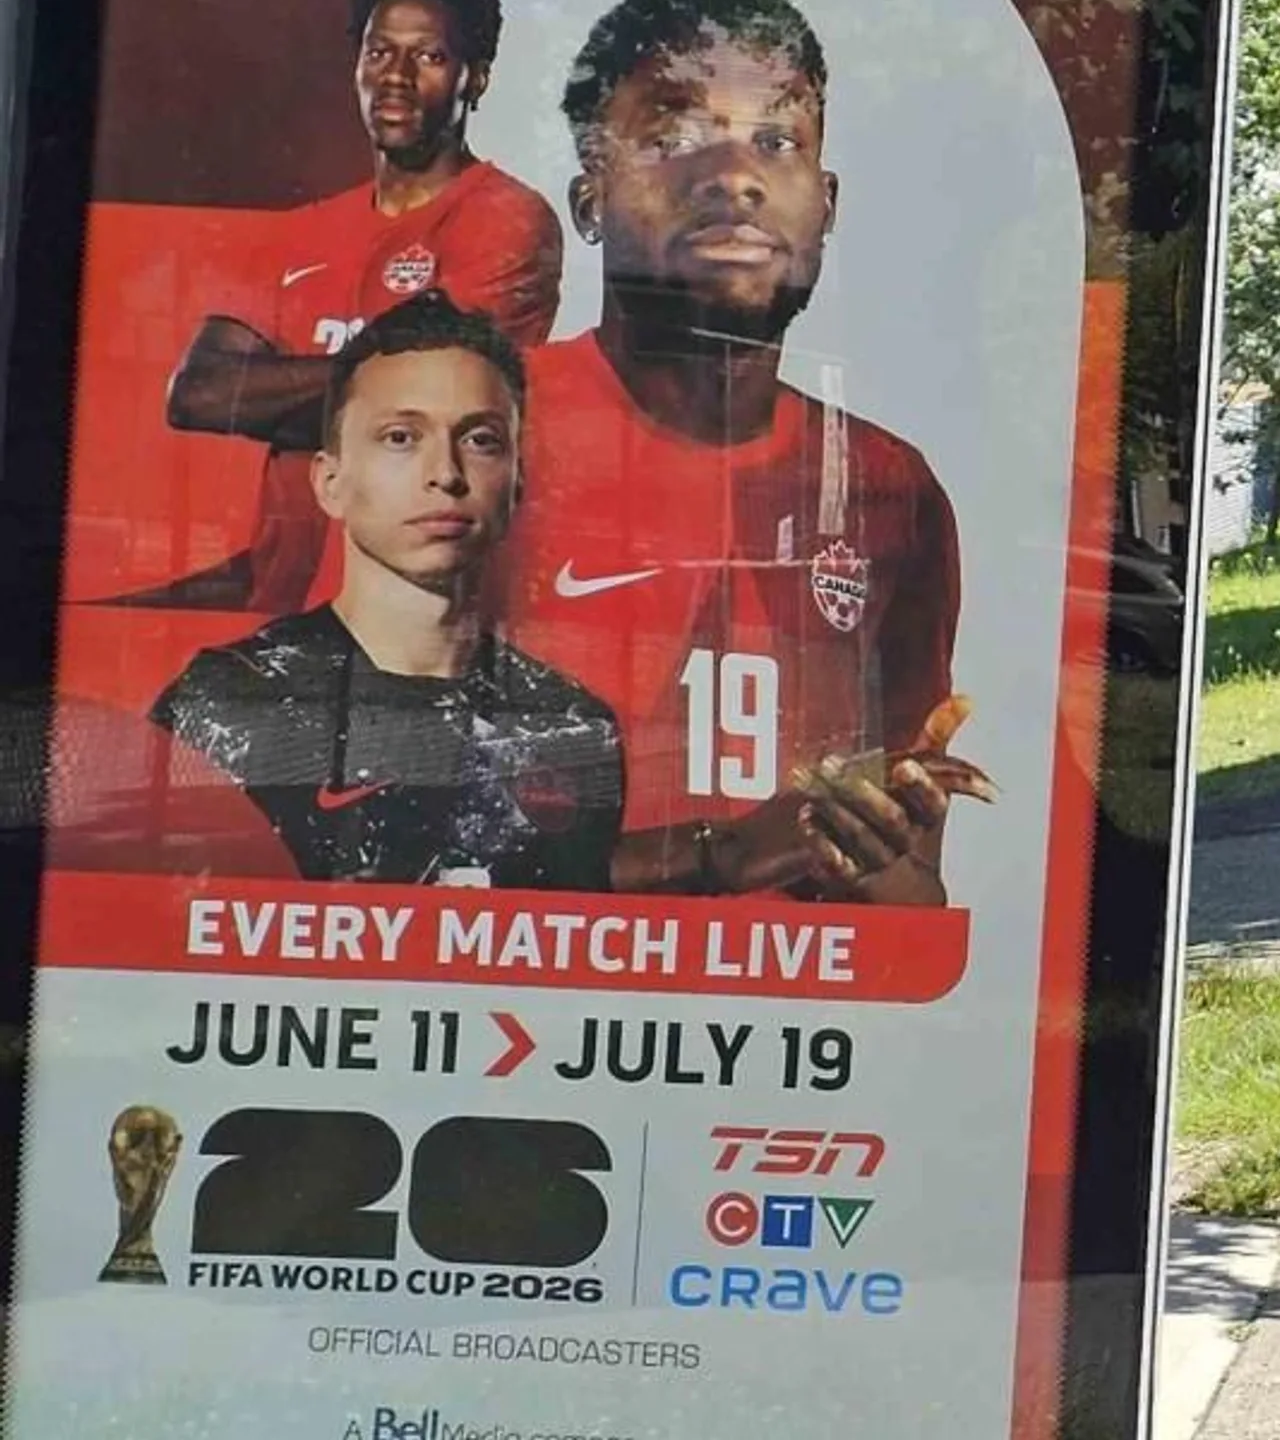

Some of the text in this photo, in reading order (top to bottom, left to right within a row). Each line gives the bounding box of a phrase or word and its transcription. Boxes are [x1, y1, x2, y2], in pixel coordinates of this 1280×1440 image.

[679, 648, 779, 800] 19
[186, 899, 856, 982] EVERY MATCH LIVE
[164, 1001, 854, 1090] JUNE 11 JULY 19
[710, 1126, 886, 1177] TSN
[191, 1107, 613, 1268] 26
[709, 1195, 871, 1246] CTV
[187, 1262, 604, 1304] FIFA WORLD CUP 2026
[308, 1327, 702, 1370] OFFICIAL BROADCASTERS
[374, 1407, 439, 1440] Bell
